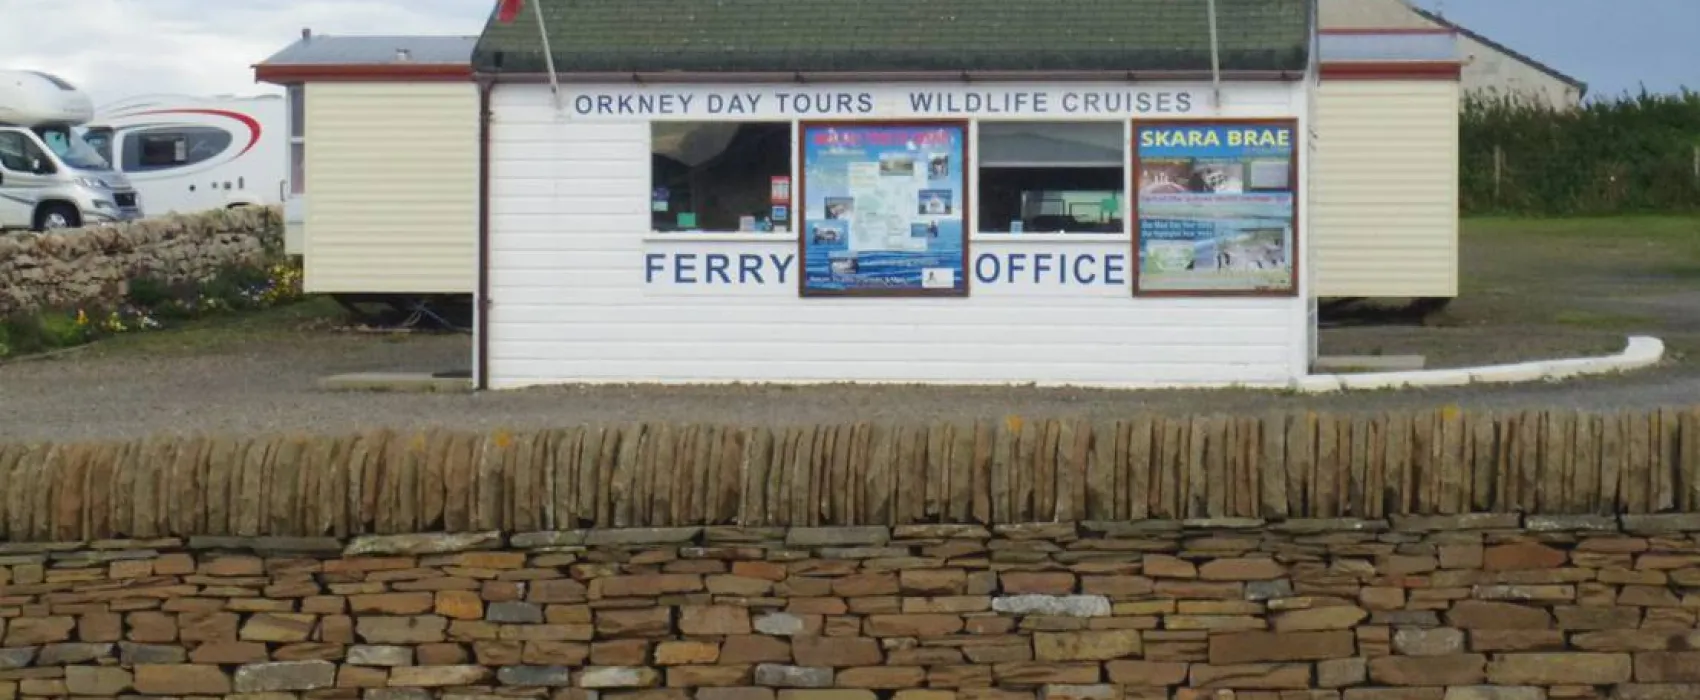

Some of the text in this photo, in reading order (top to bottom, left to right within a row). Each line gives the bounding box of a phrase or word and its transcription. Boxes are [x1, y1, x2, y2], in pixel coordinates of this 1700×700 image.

[575, 92, 873, 115] ORKNEY DAY TOURS
[910, 92, 1192, 113] WILDLIFE CRUISES
[1140, 129, 1290, 148] SKARA BRAE
[645, 254, 795, 285] FERRY
[975, 253, 1125, 285] OFFICE
